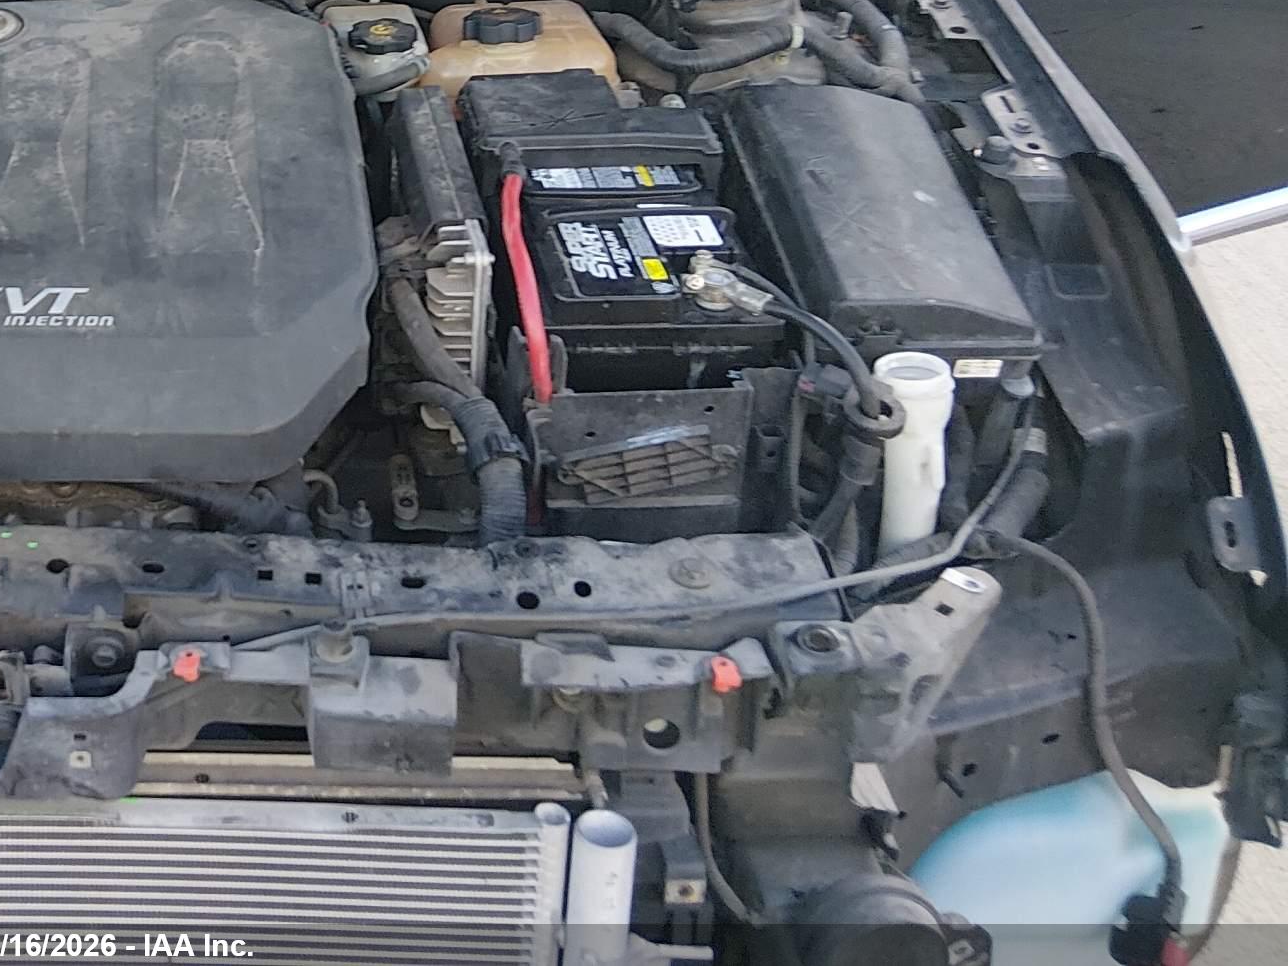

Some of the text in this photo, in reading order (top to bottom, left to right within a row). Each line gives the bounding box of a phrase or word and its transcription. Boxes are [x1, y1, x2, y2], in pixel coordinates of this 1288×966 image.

[557, 222, 593, 272] SUPER
[580, 224, 618, 280] START
[601, 229, 634, 278] PLATINUM
[3, 315, 114, 327] INJECTION
